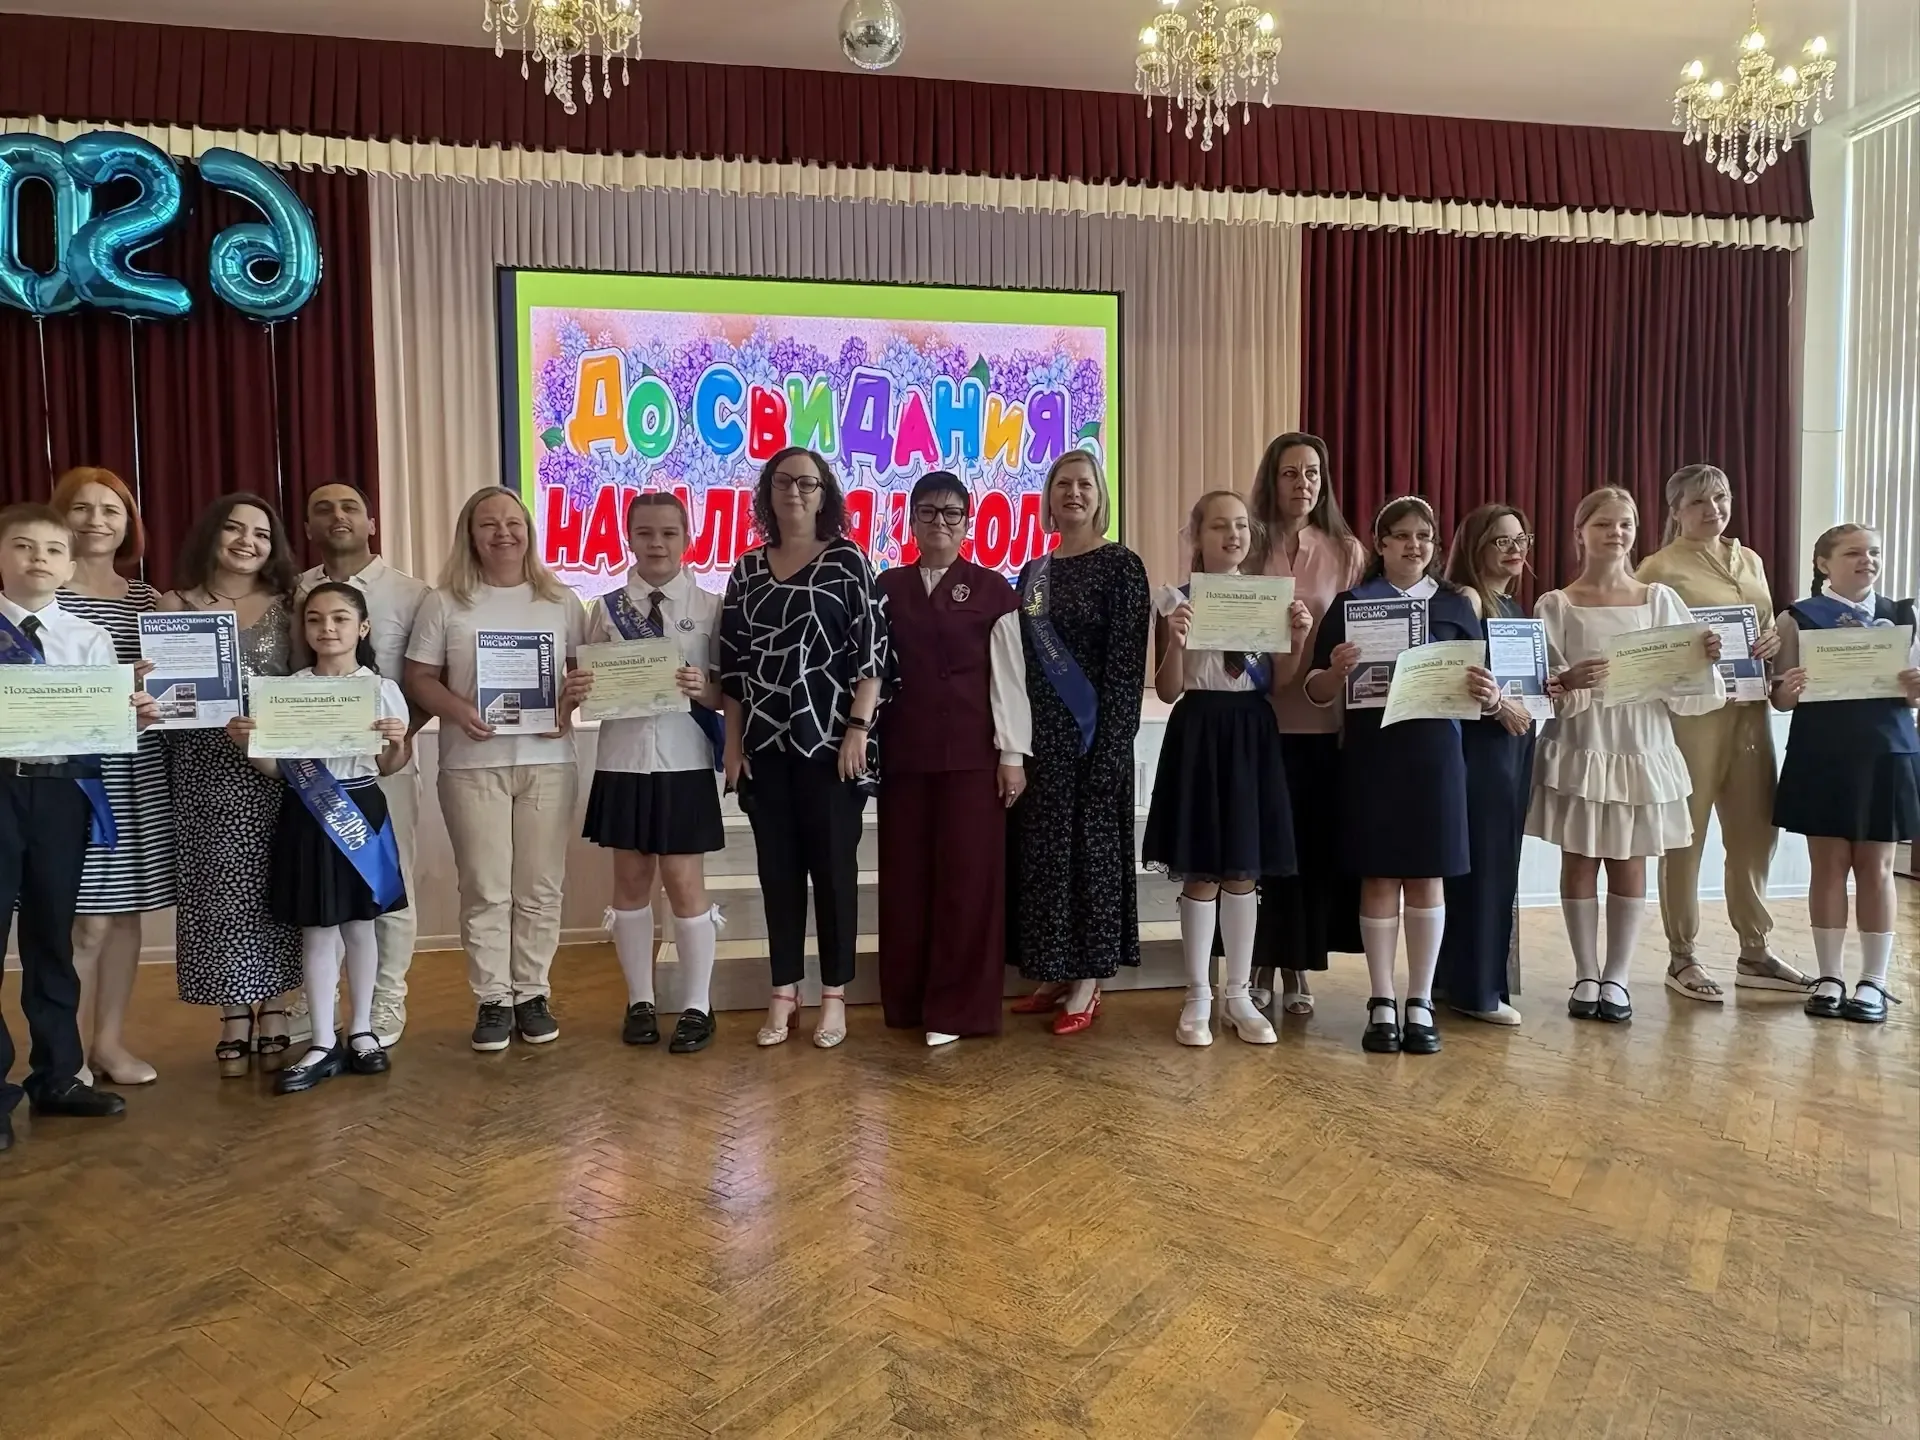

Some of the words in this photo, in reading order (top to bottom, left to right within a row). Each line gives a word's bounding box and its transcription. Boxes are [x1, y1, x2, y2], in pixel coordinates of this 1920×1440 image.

[1411, 600, 1425, 610] 2
[217, 615, 233, 625] 2
[1348, 611, 1388, 619] ПИСЬМО
[144, 624, 190, 632] ПИСЬМО
[1532, 622, 1542, 631] 2
[539, 633, 553, 643] 2
[217, 626, 231, 663] ЛИЦЕЙ
[539, 643, 551, 675] ЛИЦЕЙ
